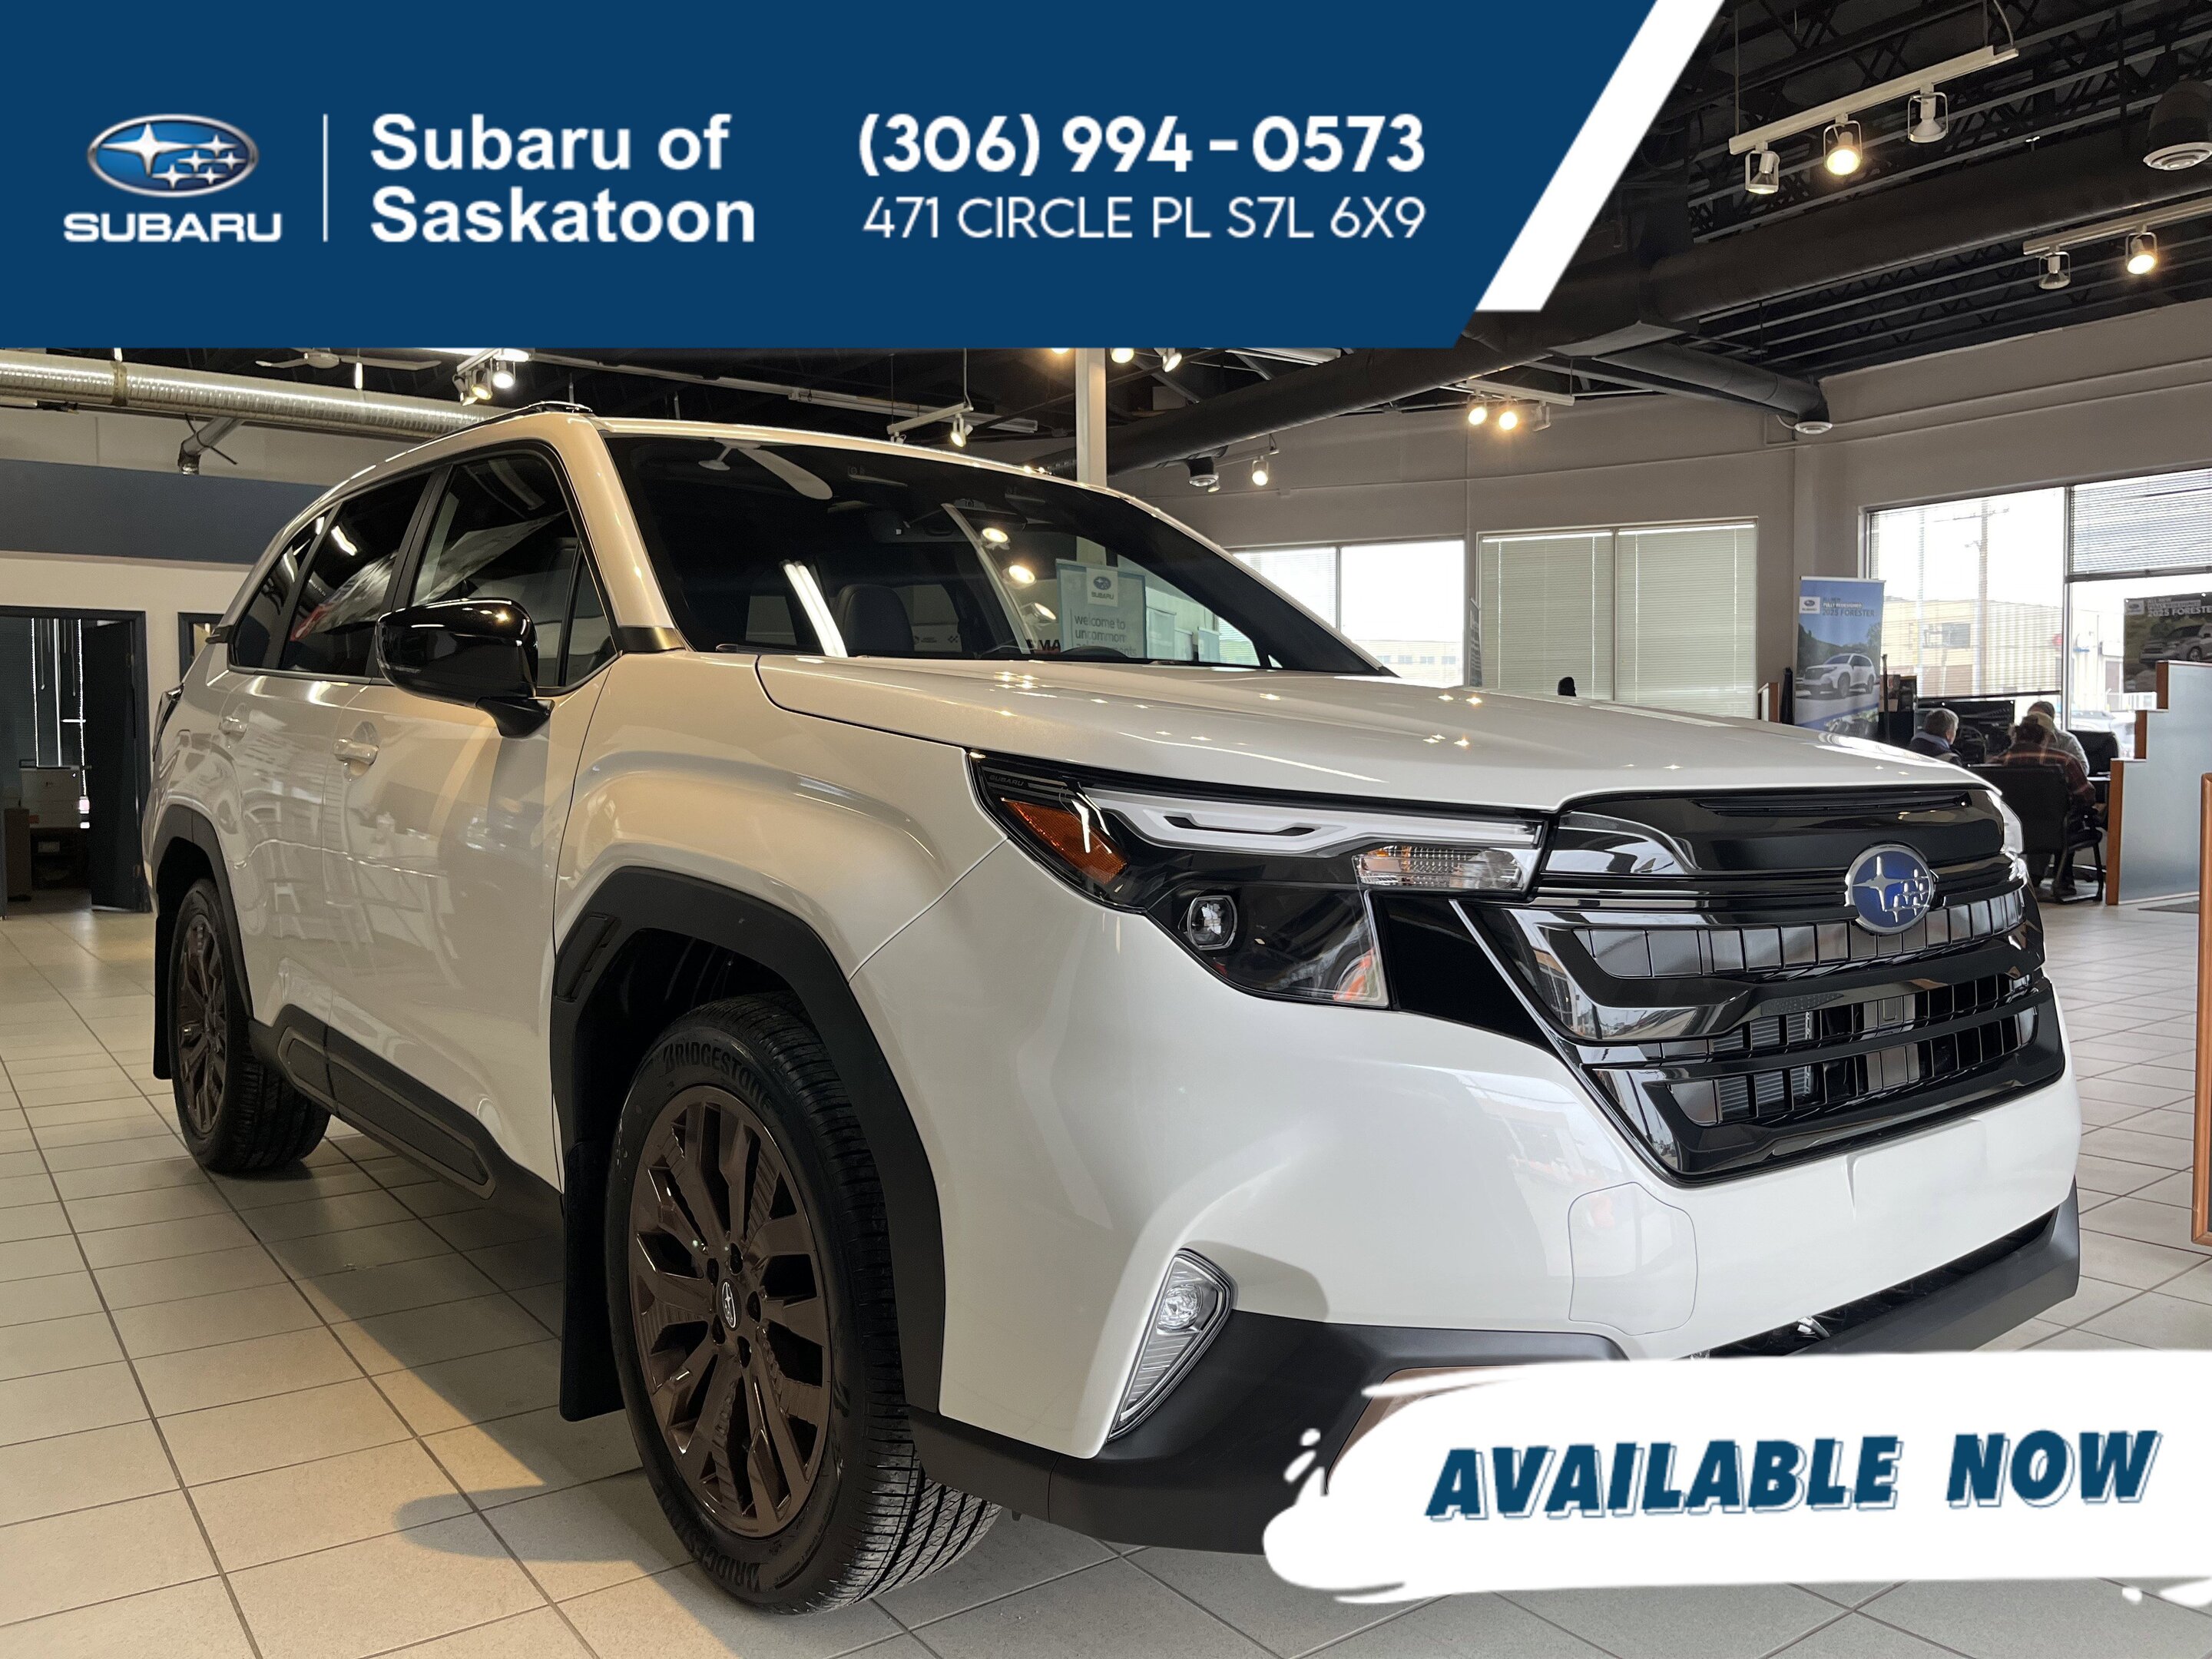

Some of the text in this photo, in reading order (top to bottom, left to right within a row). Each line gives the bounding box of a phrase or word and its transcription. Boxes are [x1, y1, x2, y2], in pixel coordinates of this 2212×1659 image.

[1091, 591, 1114, 600] SUBARU
[1841, 609, 1875, 618] FORESTER
[1117, 618, 1126, 631] to
[989, 775, 1024, 786] SUBARU
[663, 1041, 777, 1118] BRIDGESTONE
